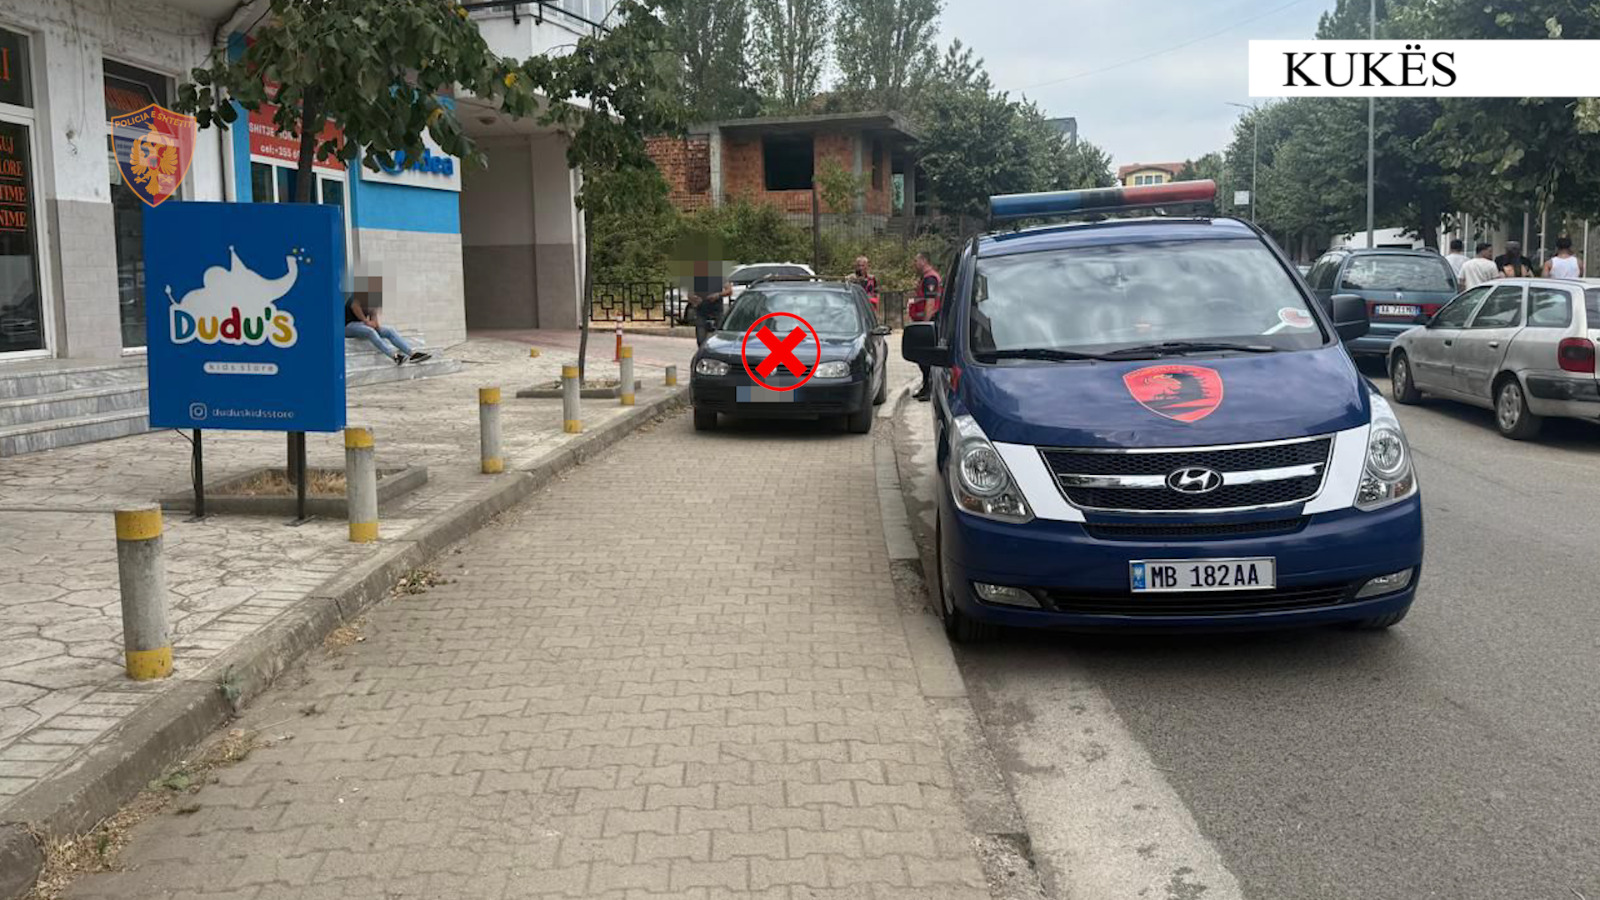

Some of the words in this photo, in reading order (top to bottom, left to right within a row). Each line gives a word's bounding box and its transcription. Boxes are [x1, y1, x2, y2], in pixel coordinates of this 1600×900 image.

[173, 306, 294, 344] Dudu's
[208, 363, 236, 371] kids
[240, 364, 274, 372] store
[212, 408, 294, 419] duduskidsstore
[1151, 566, 1177, 588] MB
